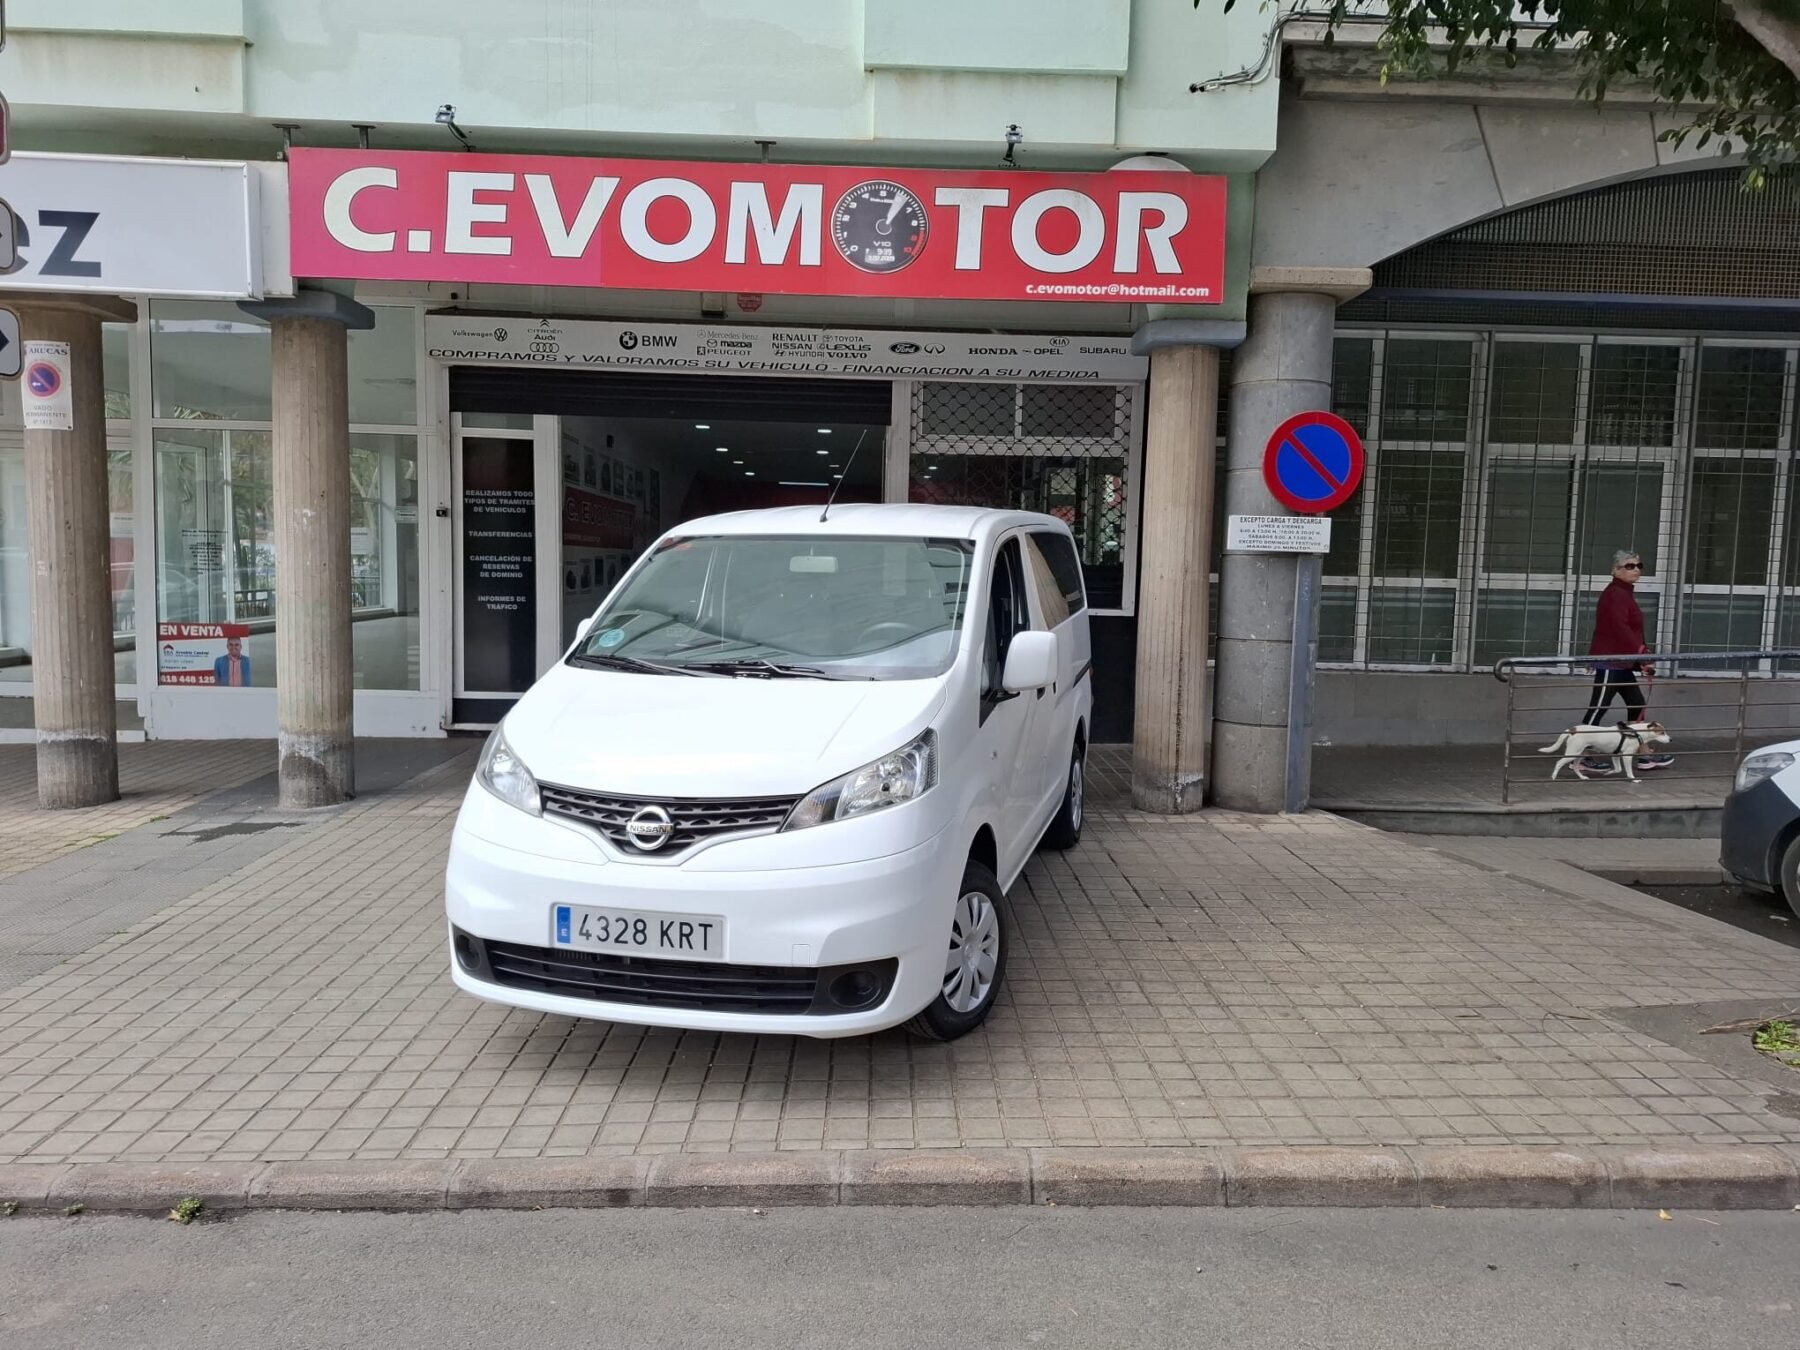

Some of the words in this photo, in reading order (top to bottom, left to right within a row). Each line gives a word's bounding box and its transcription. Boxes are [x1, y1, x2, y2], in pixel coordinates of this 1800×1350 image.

[1026, 283, 1209, 297] c.evomotor@hotmail.com
[452, 329, 493, 338] Volkswagen
[642, 335, 677, 347] BMW
[772, 333, 818, 343] RENAULT
[834, 335, 864, 343] TOYOTA
[1052, 338, 1068, 346] KIA
[771, 342, 813, 350] NISSAN
[826, 343, 872, 351] LEXUS
[707, 348, 752, 356] PEUGEOT
[968, 347, 1018, 355] HONDA
[1079, 346, 1127, 355] SUBARU
[827, 351, 868, 359] VOLVO
[429, 349, 557, 362] COMPRAMOS
[582, 354, 699, 367] VALORAMOS
[704, 360, 730, 368] SU
[738, 361, 828, 371] VEHICULO
[842, 364, 974, 376] FINANCIACION
[977, 368, 990, 376] A
[995, 368, 1022, 377] SU
[1028, 370, 1099, 379] MEDIDA
[1240, 516, 1266, 524] EXCEPTO
[468, 530, 533, 538] TRANSFERENCIAS
[160, 625, 177, 636] EN
[181, 625, 224, 637] VENTA
[629, 824, 669, 833] NISSAN
[578, 913, 648, 946] 4328
[659, 919, 714, 951] KRT
